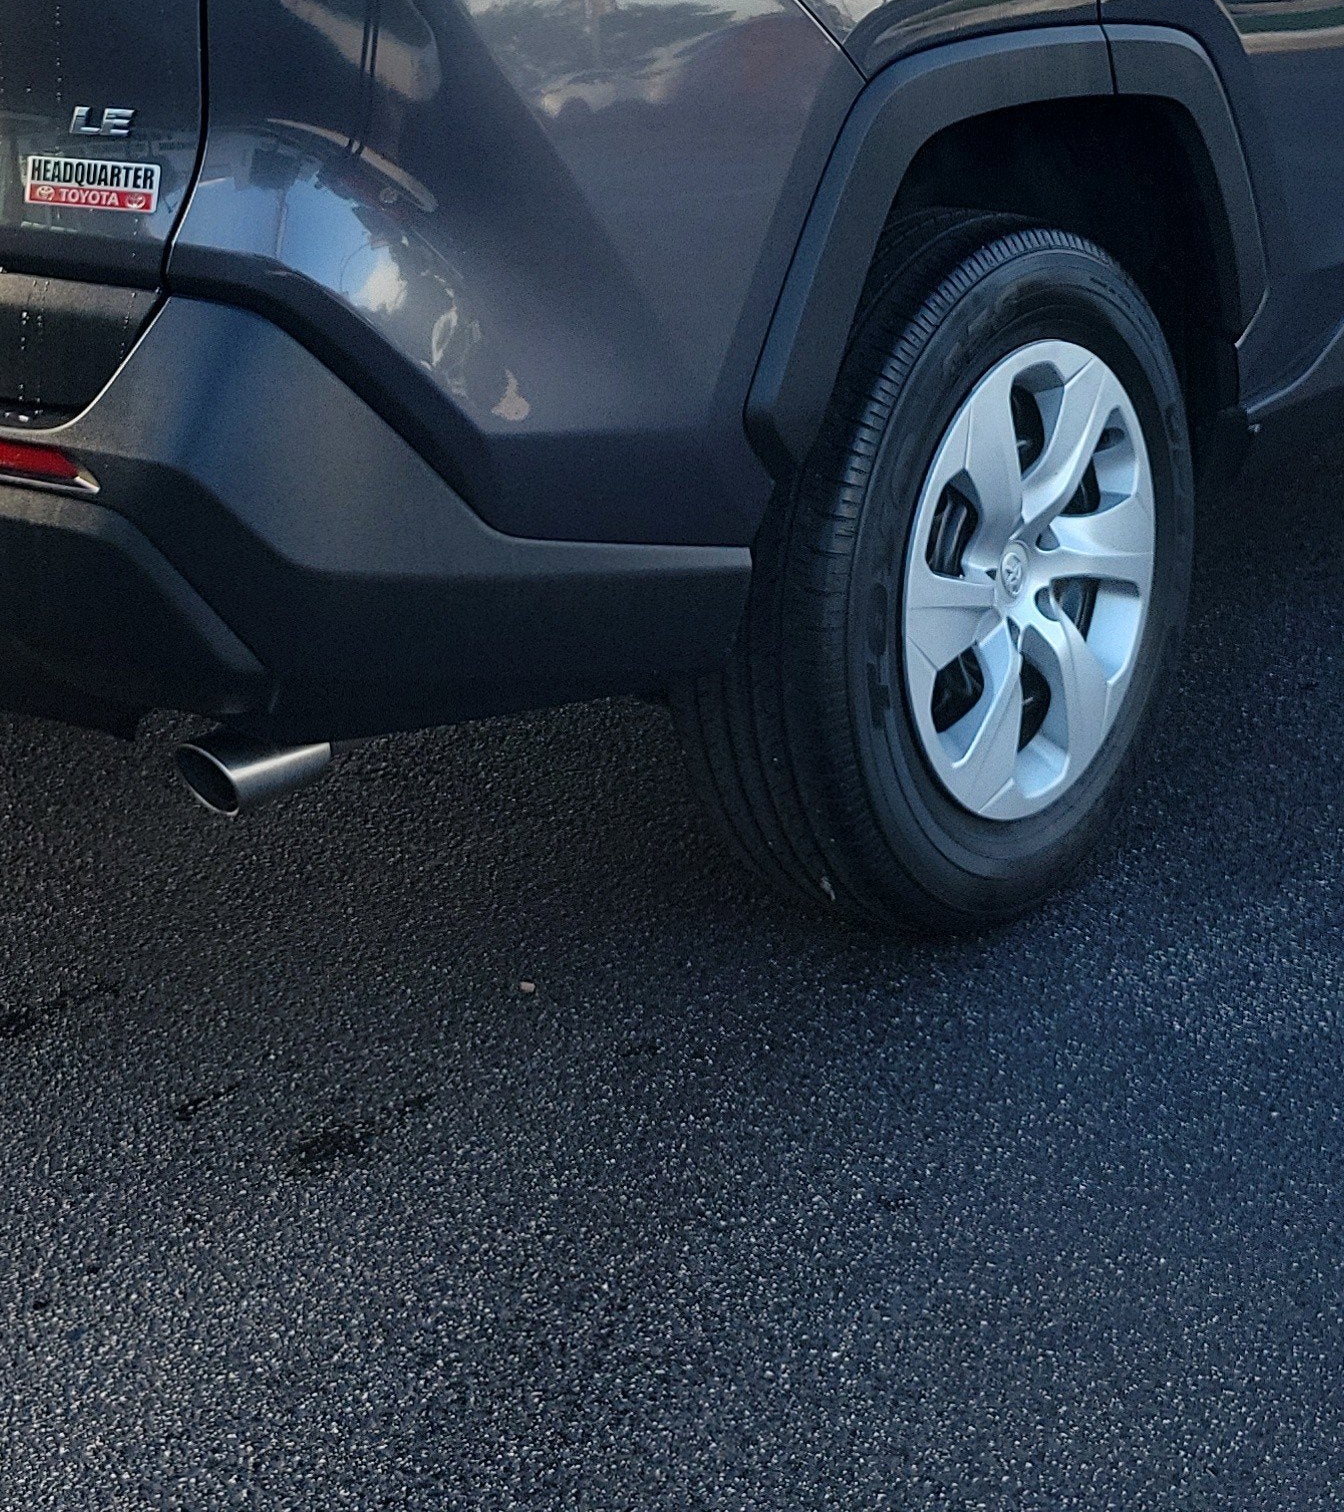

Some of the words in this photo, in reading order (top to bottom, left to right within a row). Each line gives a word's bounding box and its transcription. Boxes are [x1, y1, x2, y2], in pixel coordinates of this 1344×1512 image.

[69, 106, 137, 137] LE
[31, 158, 155, 190] HEADQUARTER
[58, 188, 120, 206] TOYOTA
